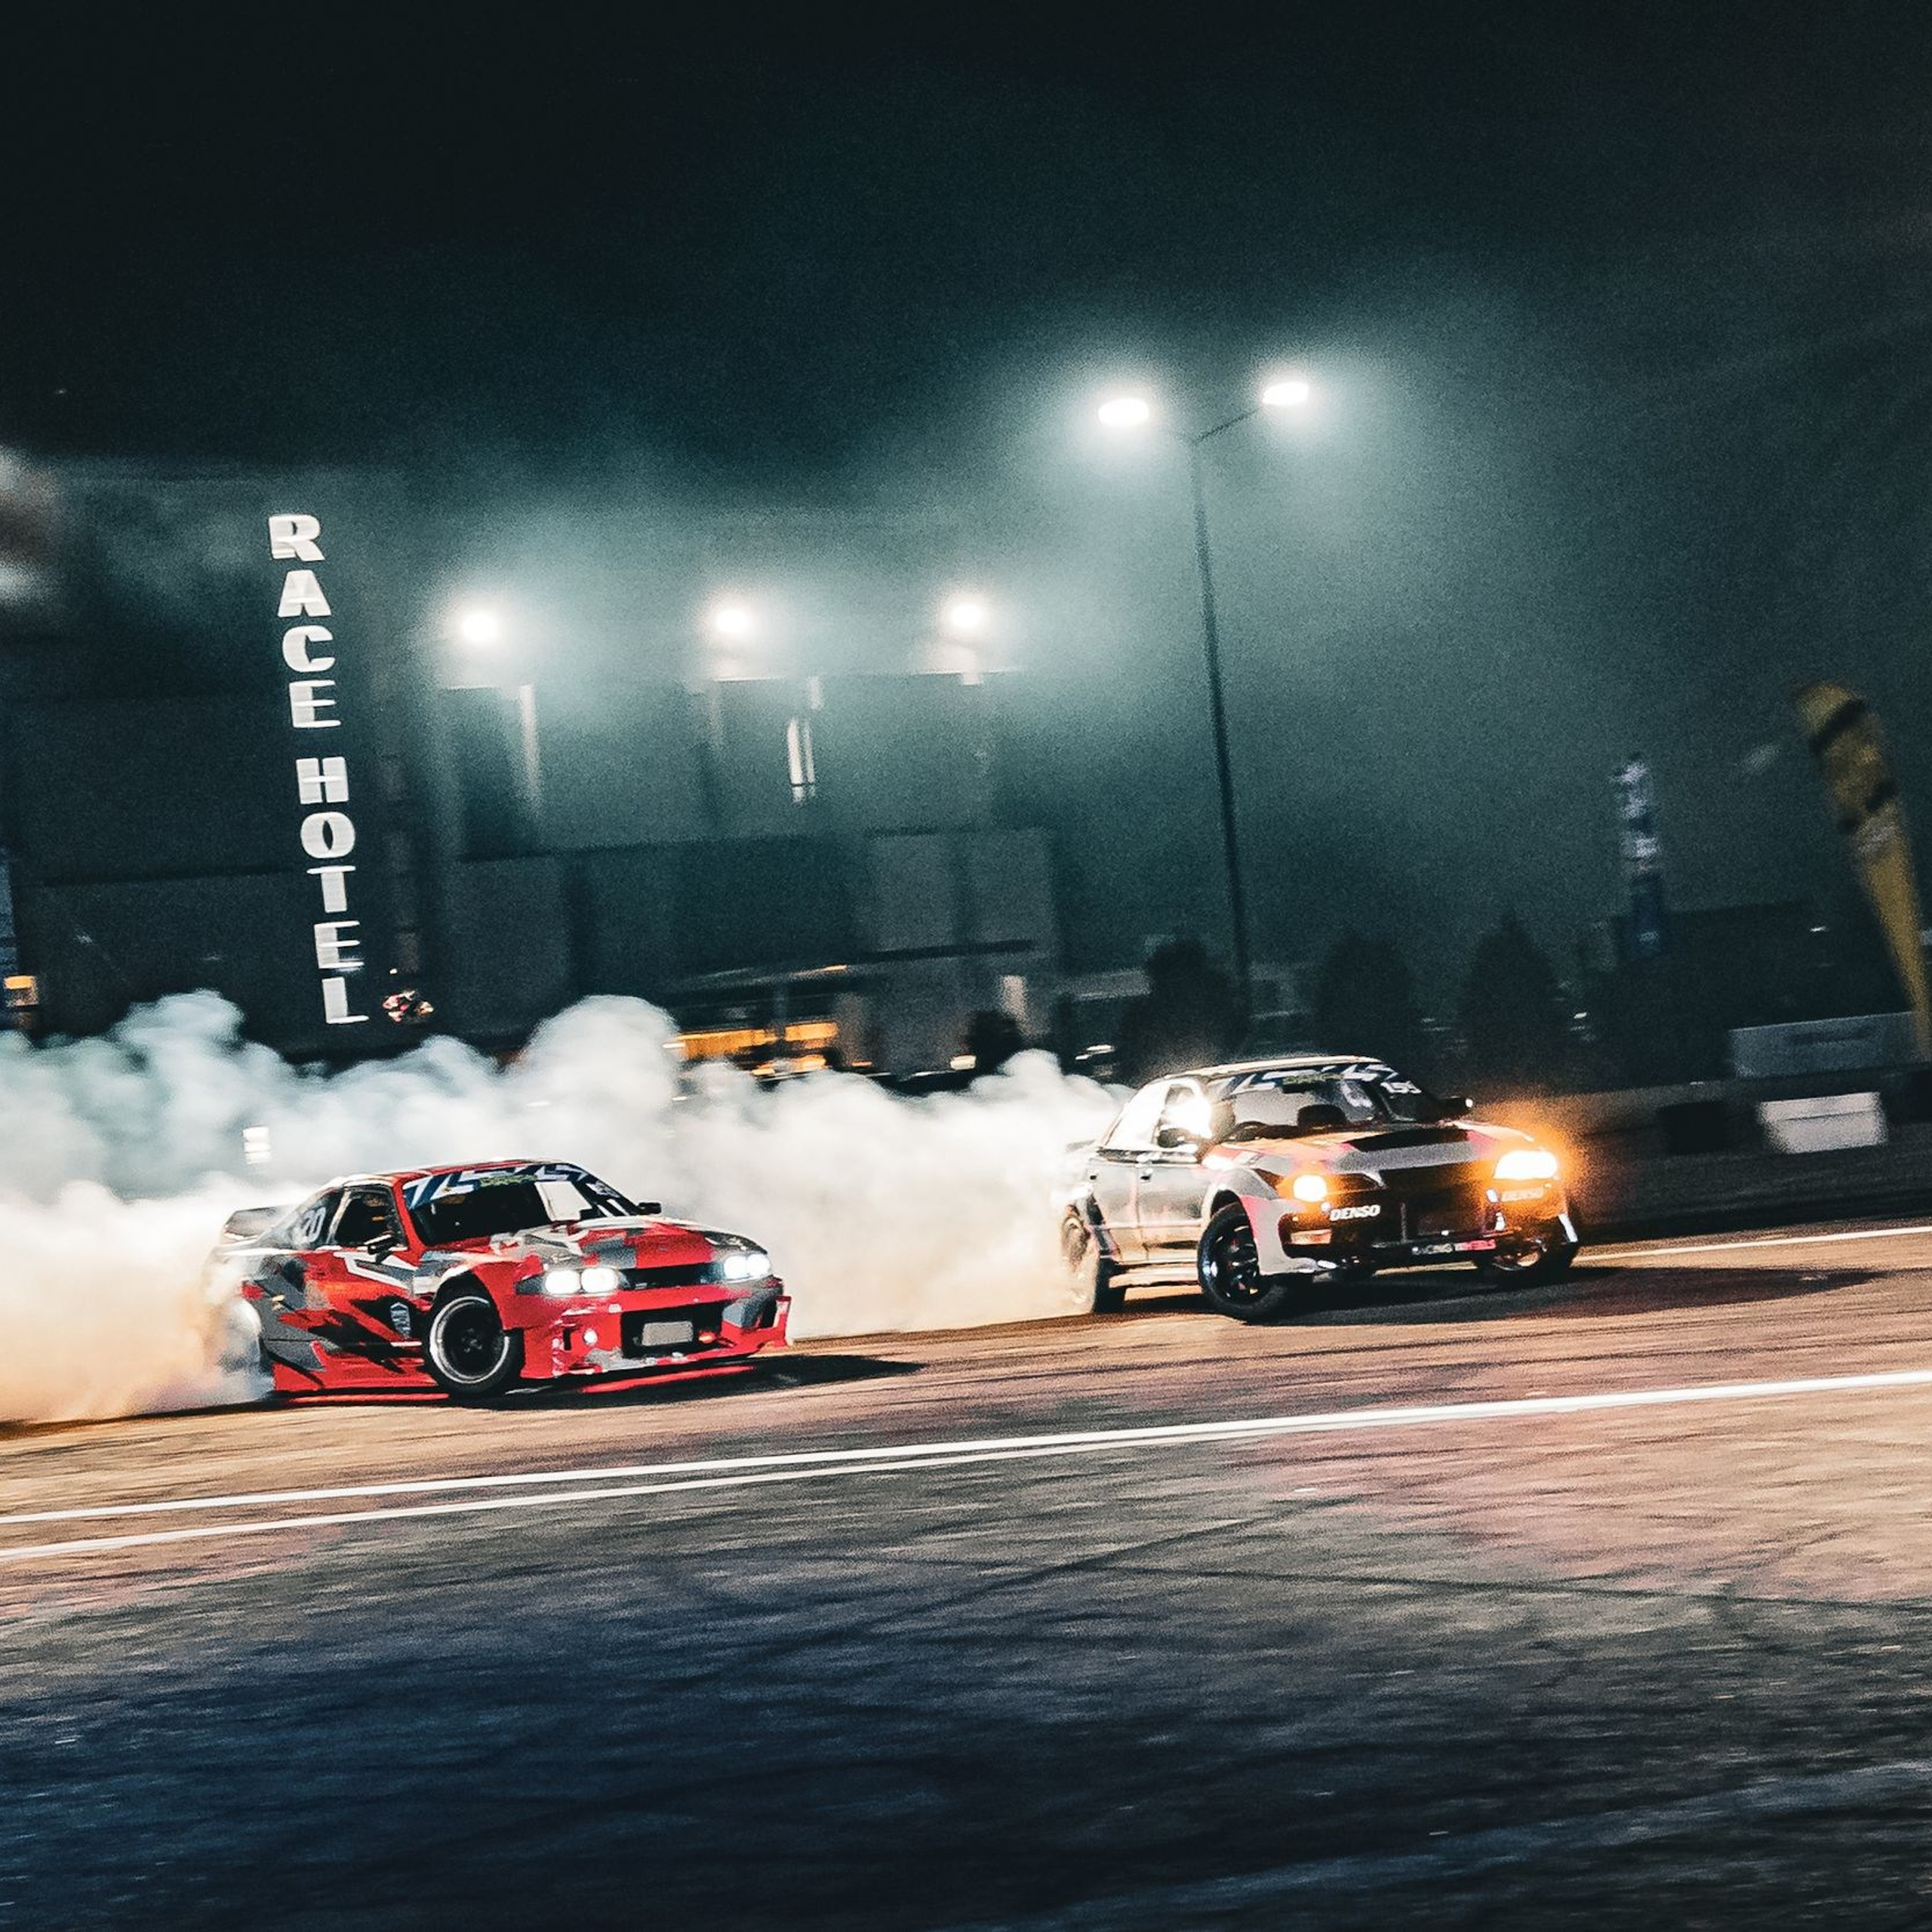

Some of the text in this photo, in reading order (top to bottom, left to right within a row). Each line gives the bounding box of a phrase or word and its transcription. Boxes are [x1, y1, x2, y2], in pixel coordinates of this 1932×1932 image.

[269, 514, 369, 1024] RACE HOTEL
[1329, 1204, 1381, 1222] DENSO
